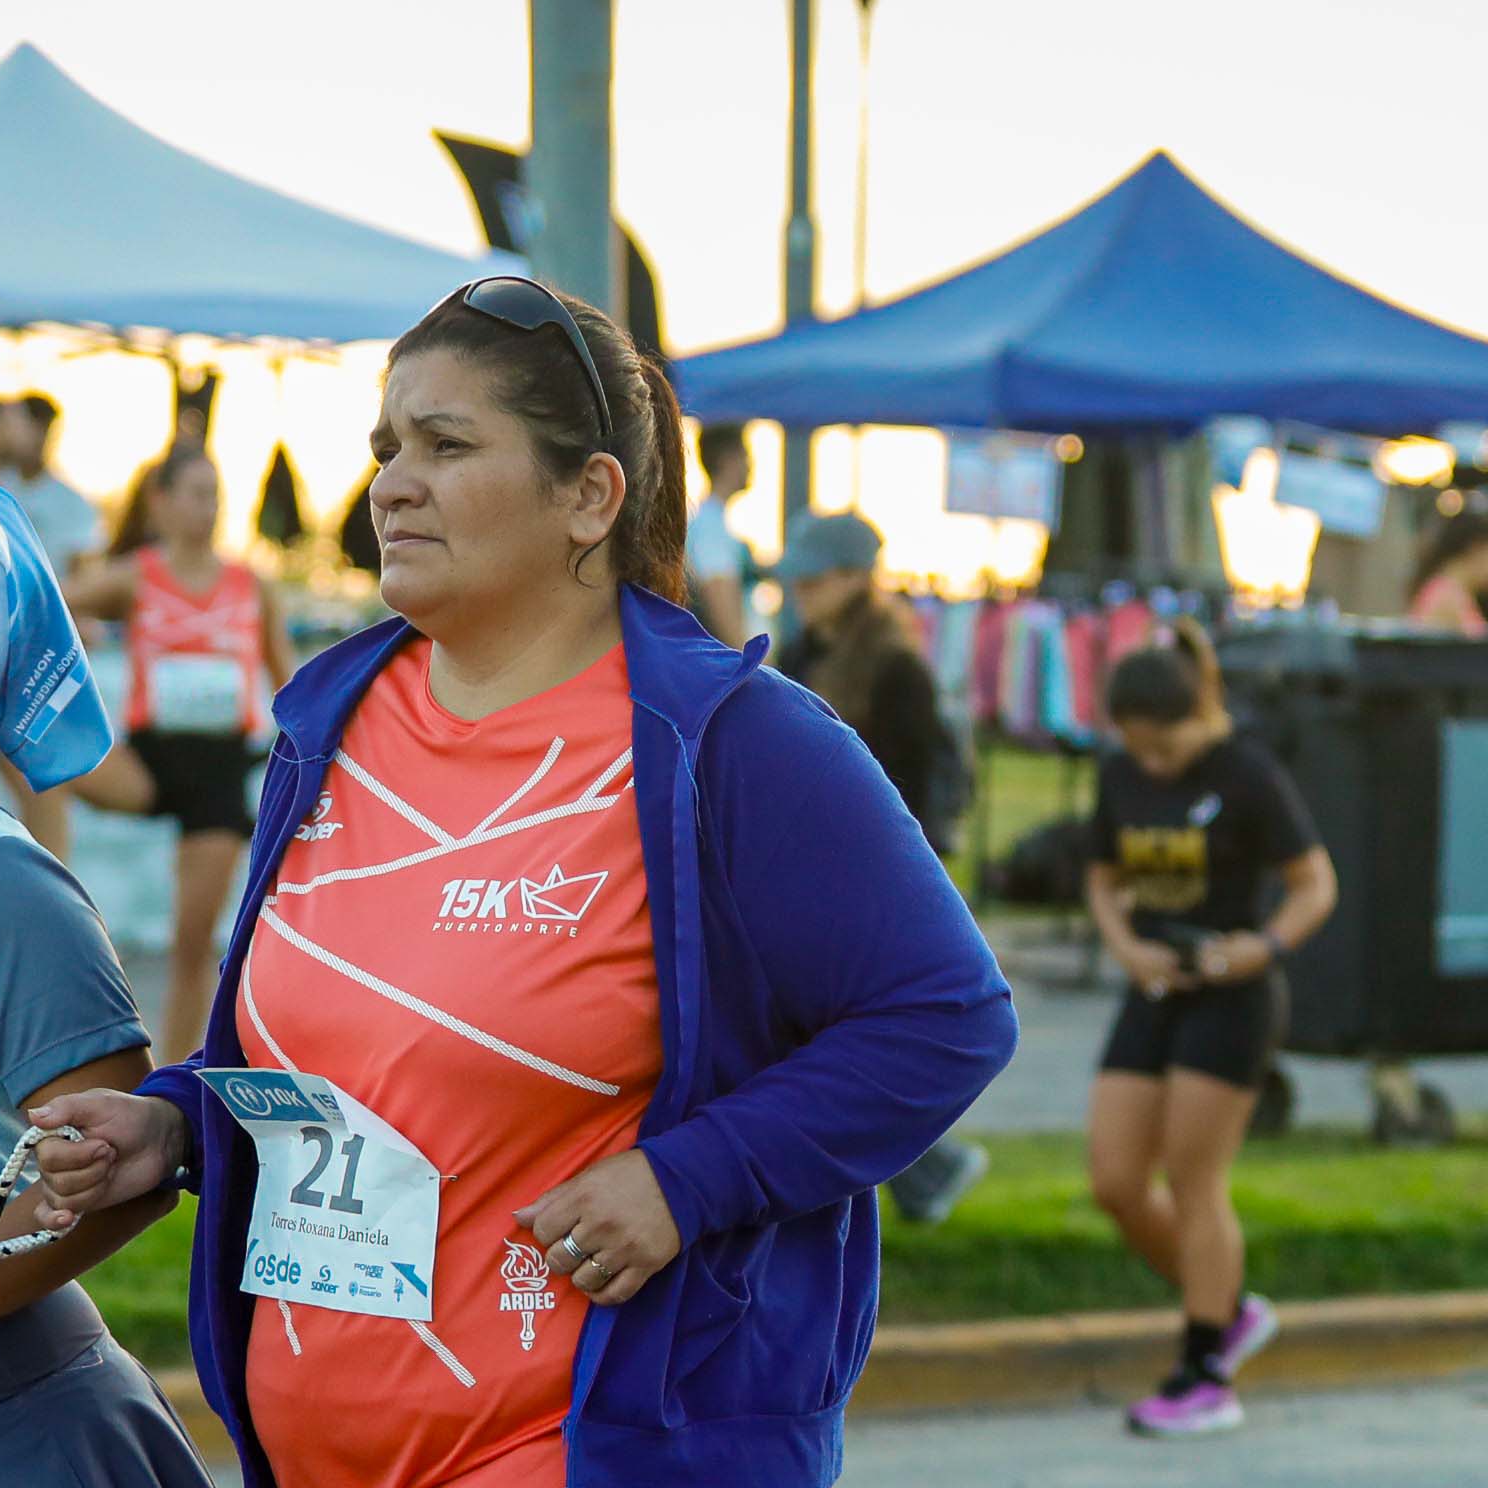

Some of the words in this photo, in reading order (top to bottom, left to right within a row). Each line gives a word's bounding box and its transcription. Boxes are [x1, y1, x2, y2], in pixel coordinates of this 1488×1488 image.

[13, 671, 60, 735] ARGENTINA!
[438, 879, 518, 919] 15K
[432, 922, 503, 933] PUERTO
[510, 922, 578, 938] NORTE
[264, 1087, 309, 1108] 10K
[311, 1092, 341, 1111] 15
[290, 1125, 366, 1216] 21
[271, 1211, 297, 1232] Torres
[299, 1216, 335, 1239] Roxana
[338, 1223, 389, 1246] Daniela
[255, 1252, 302, 1286] osde
[499, 1291, 556, 1311] ARDEC
